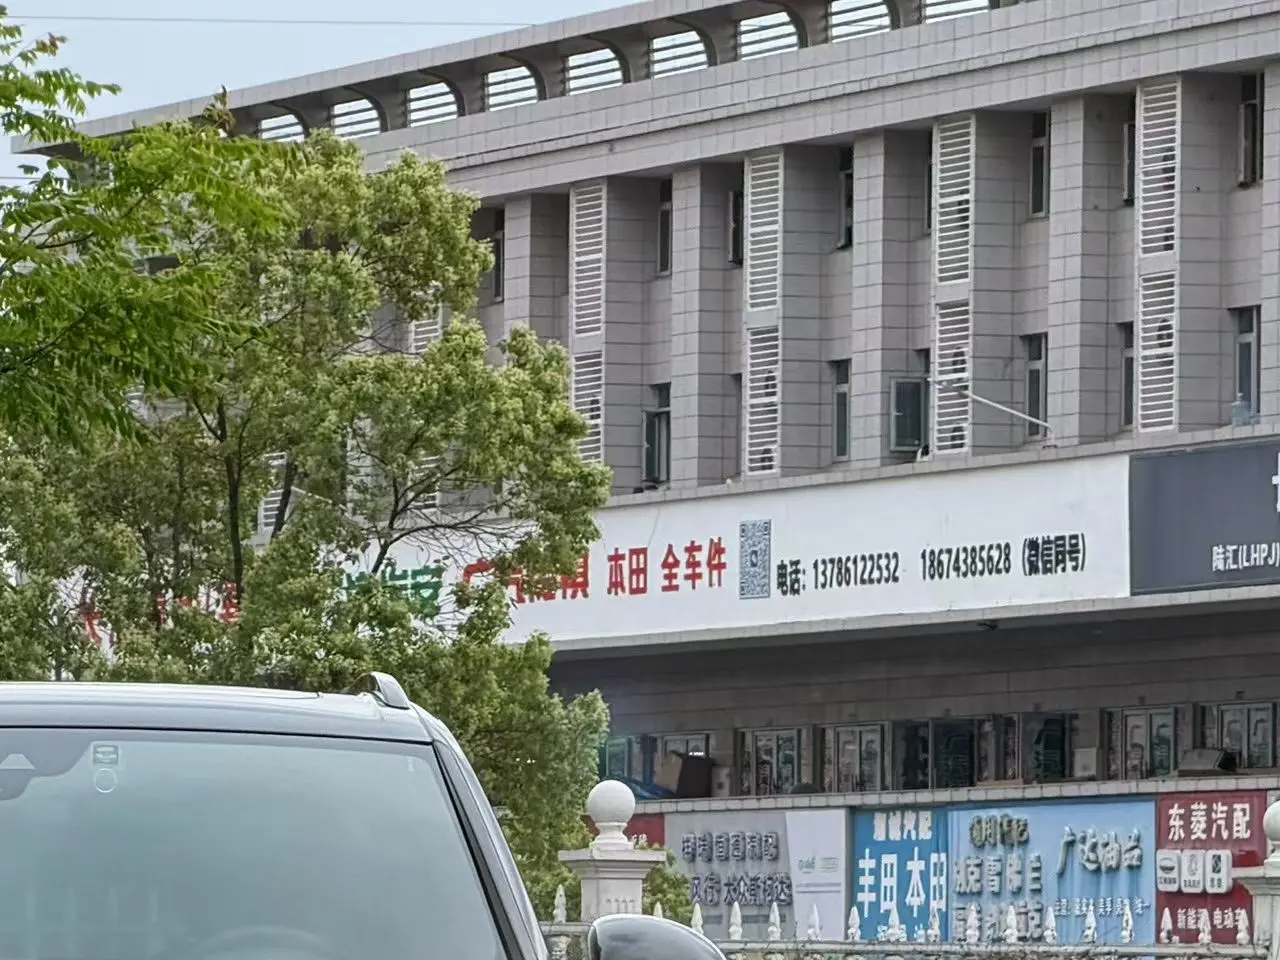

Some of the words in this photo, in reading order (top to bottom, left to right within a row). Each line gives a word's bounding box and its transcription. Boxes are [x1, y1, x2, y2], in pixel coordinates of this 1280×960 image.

[607, 547, 648, 596] 本田
[660, 536, 727, 592] 全车件
[920, 542, 1012, 581] 18674385628
[1168, 802, 1251, 841] 东菱汽配
[857, 846, 948, 918] 丰田本田
